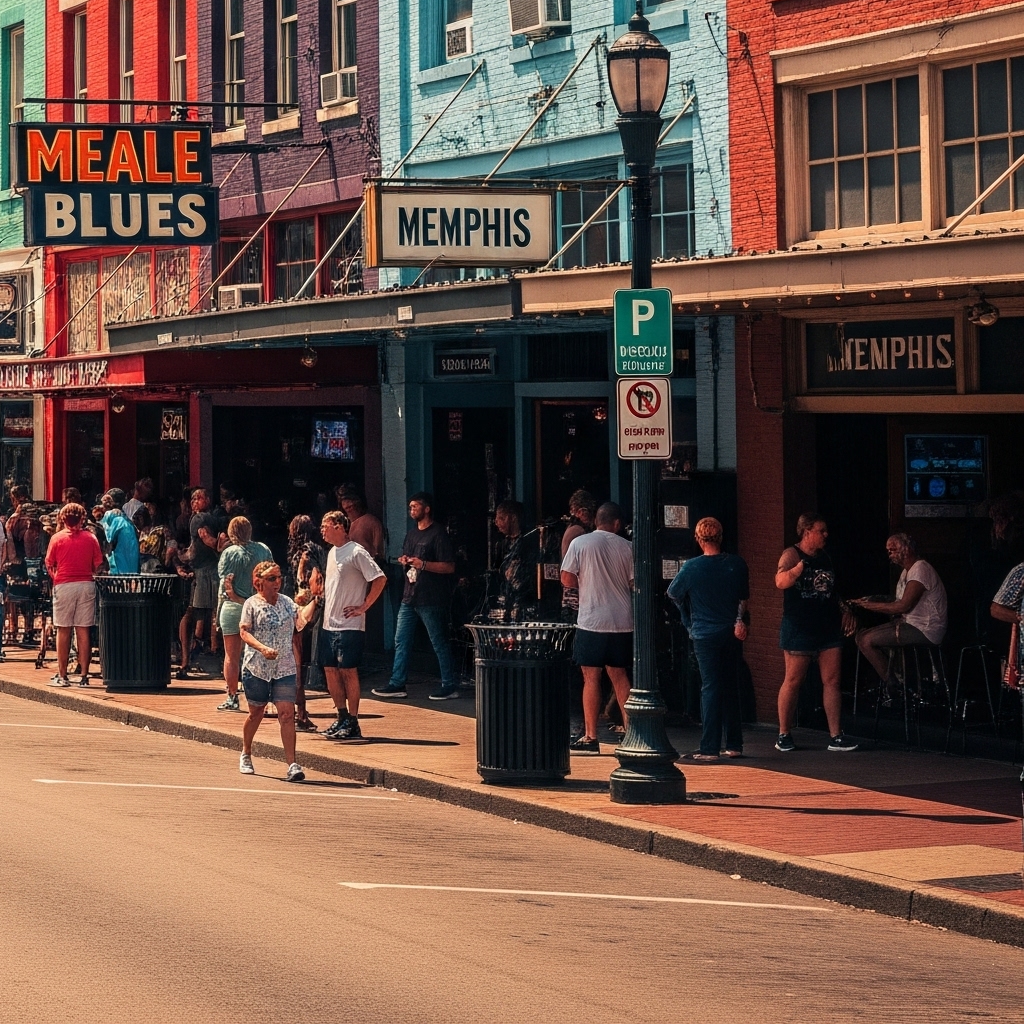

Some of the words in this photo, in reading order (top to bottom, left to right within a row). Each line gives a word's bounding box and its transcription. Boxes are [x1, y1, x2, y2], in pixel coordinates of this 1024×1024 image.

[27, 129, 202, 183] MEALE
[45, 193, 207, 237] BLUES
[398, 207, 531, 247] MEMPHIS
[632, 299, 655, 335] P
